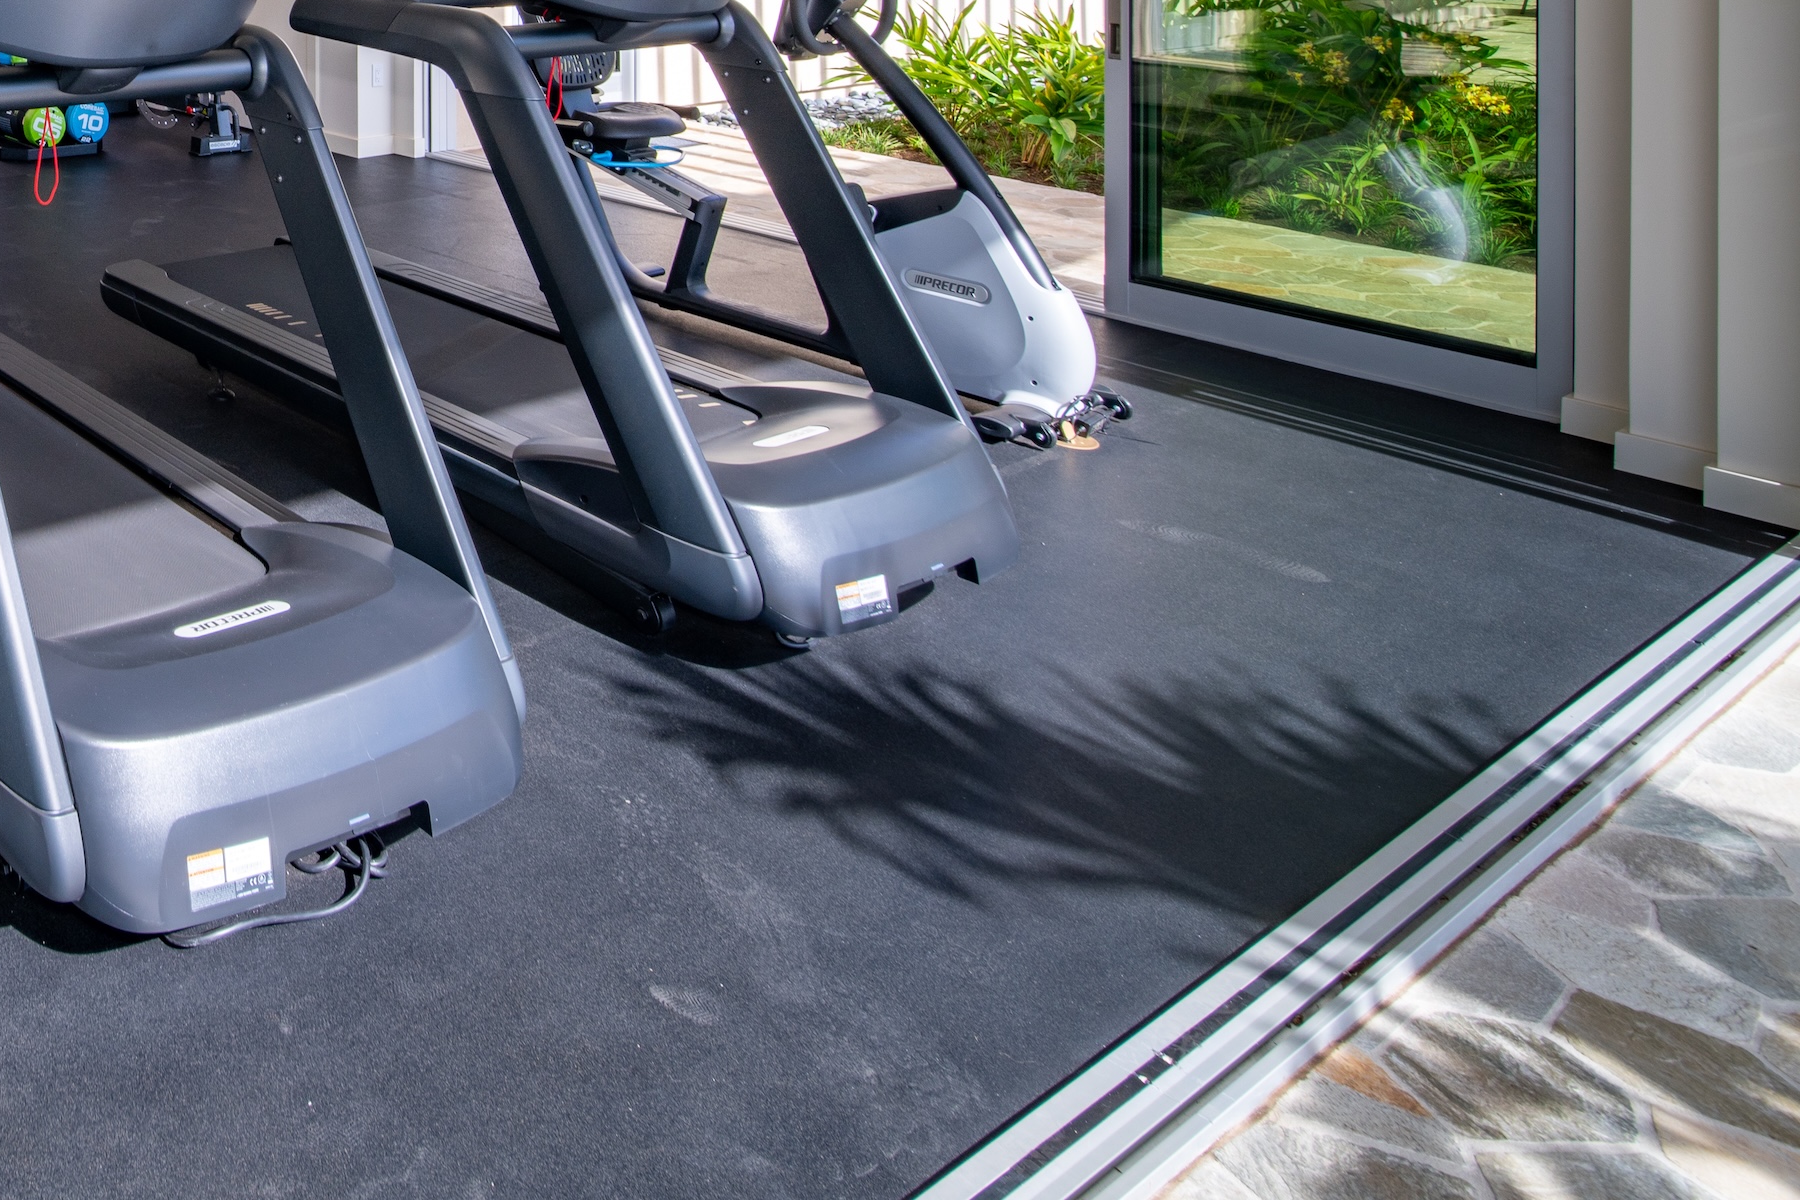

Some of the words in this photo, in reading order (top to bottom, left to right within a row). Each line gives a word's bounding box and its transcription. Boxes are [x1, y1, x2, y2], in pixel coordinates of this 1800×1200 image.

[78, 113, 103, 131] 10
[922, 276, 977, 298] PRECOR
[191, 606, 265, 632] PRECOR
